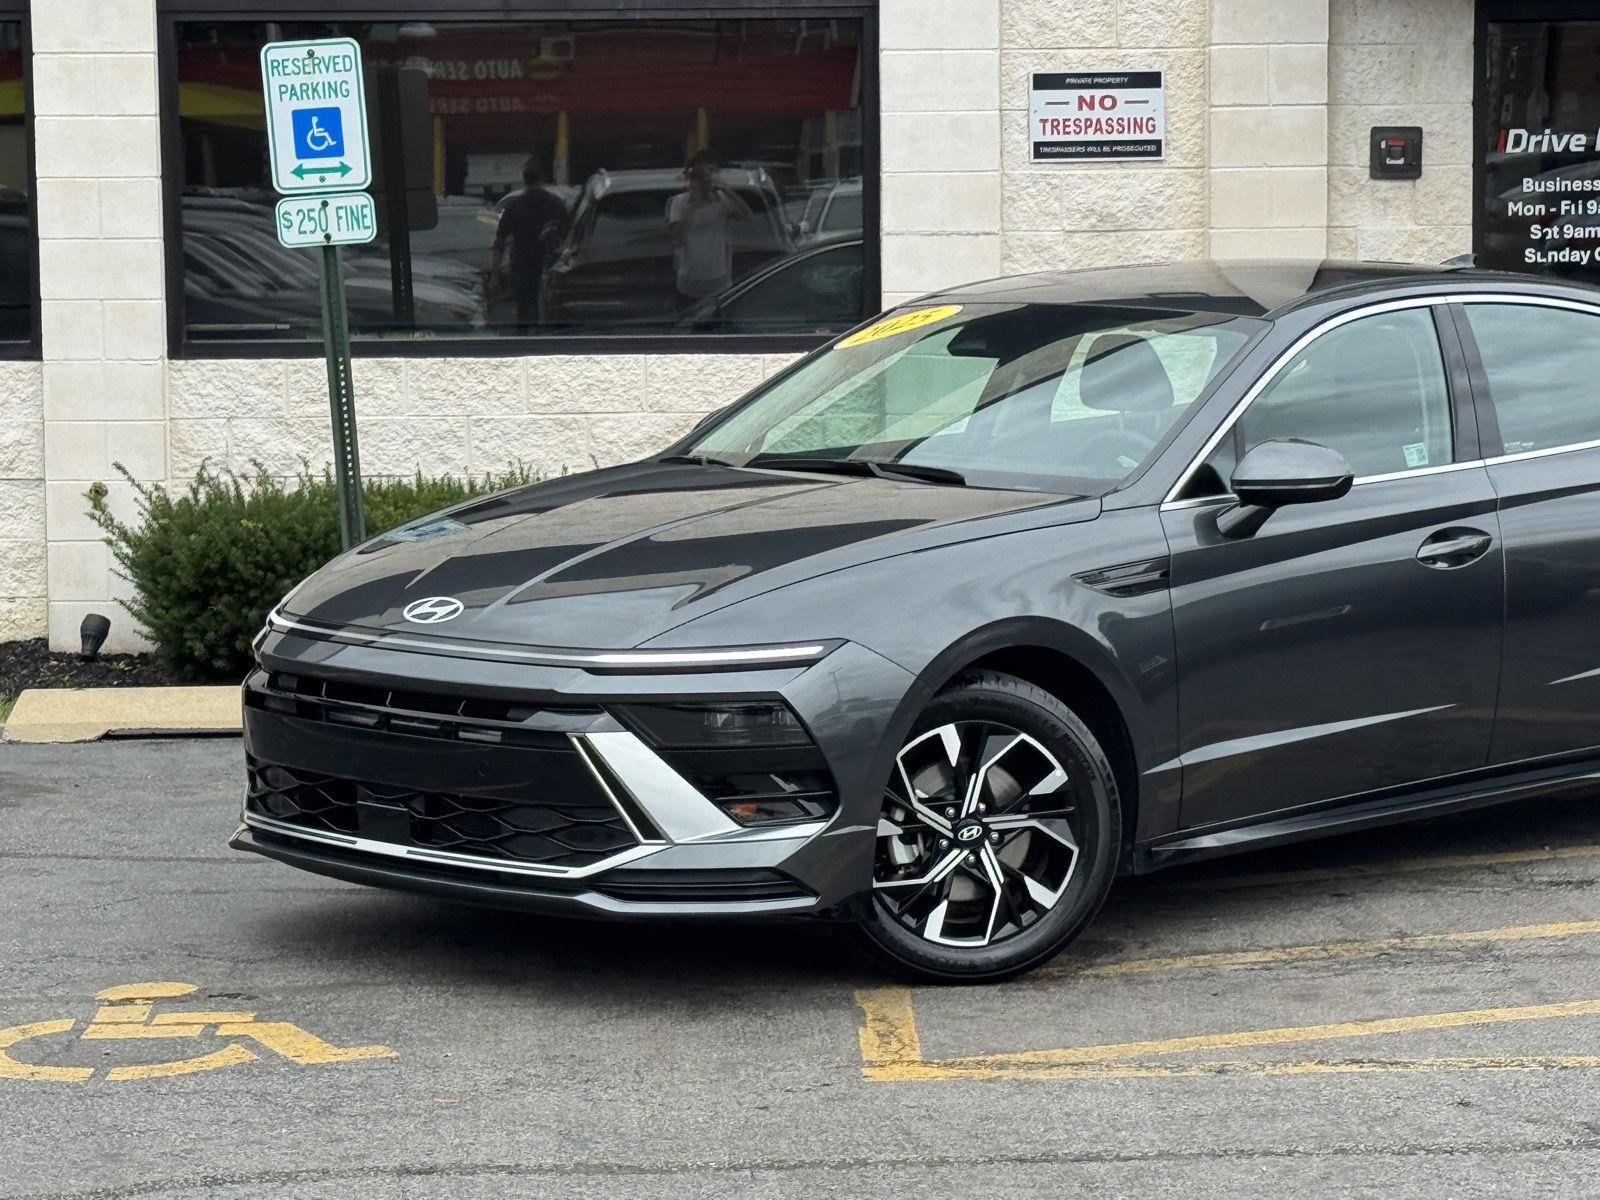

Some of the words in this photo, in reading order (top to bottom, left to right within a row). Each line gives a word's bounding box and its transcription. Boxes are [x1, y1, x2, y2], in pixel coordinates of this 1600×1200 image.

[270, 54, 353, 78] RESERVED
[278, 79, 350, 102] PARKING
[1077, 94, 1118, 112] NO
[1038, 116, 1157, 136] TRESPASSING
[1522, 177, 1600, 193] Business
[1507, 201, 1546, 217] Mon
[281, 205, 329, 235] $250
[336, 203, 371, 232] FINE
[1524, 247, 1591, 265] Sunday
